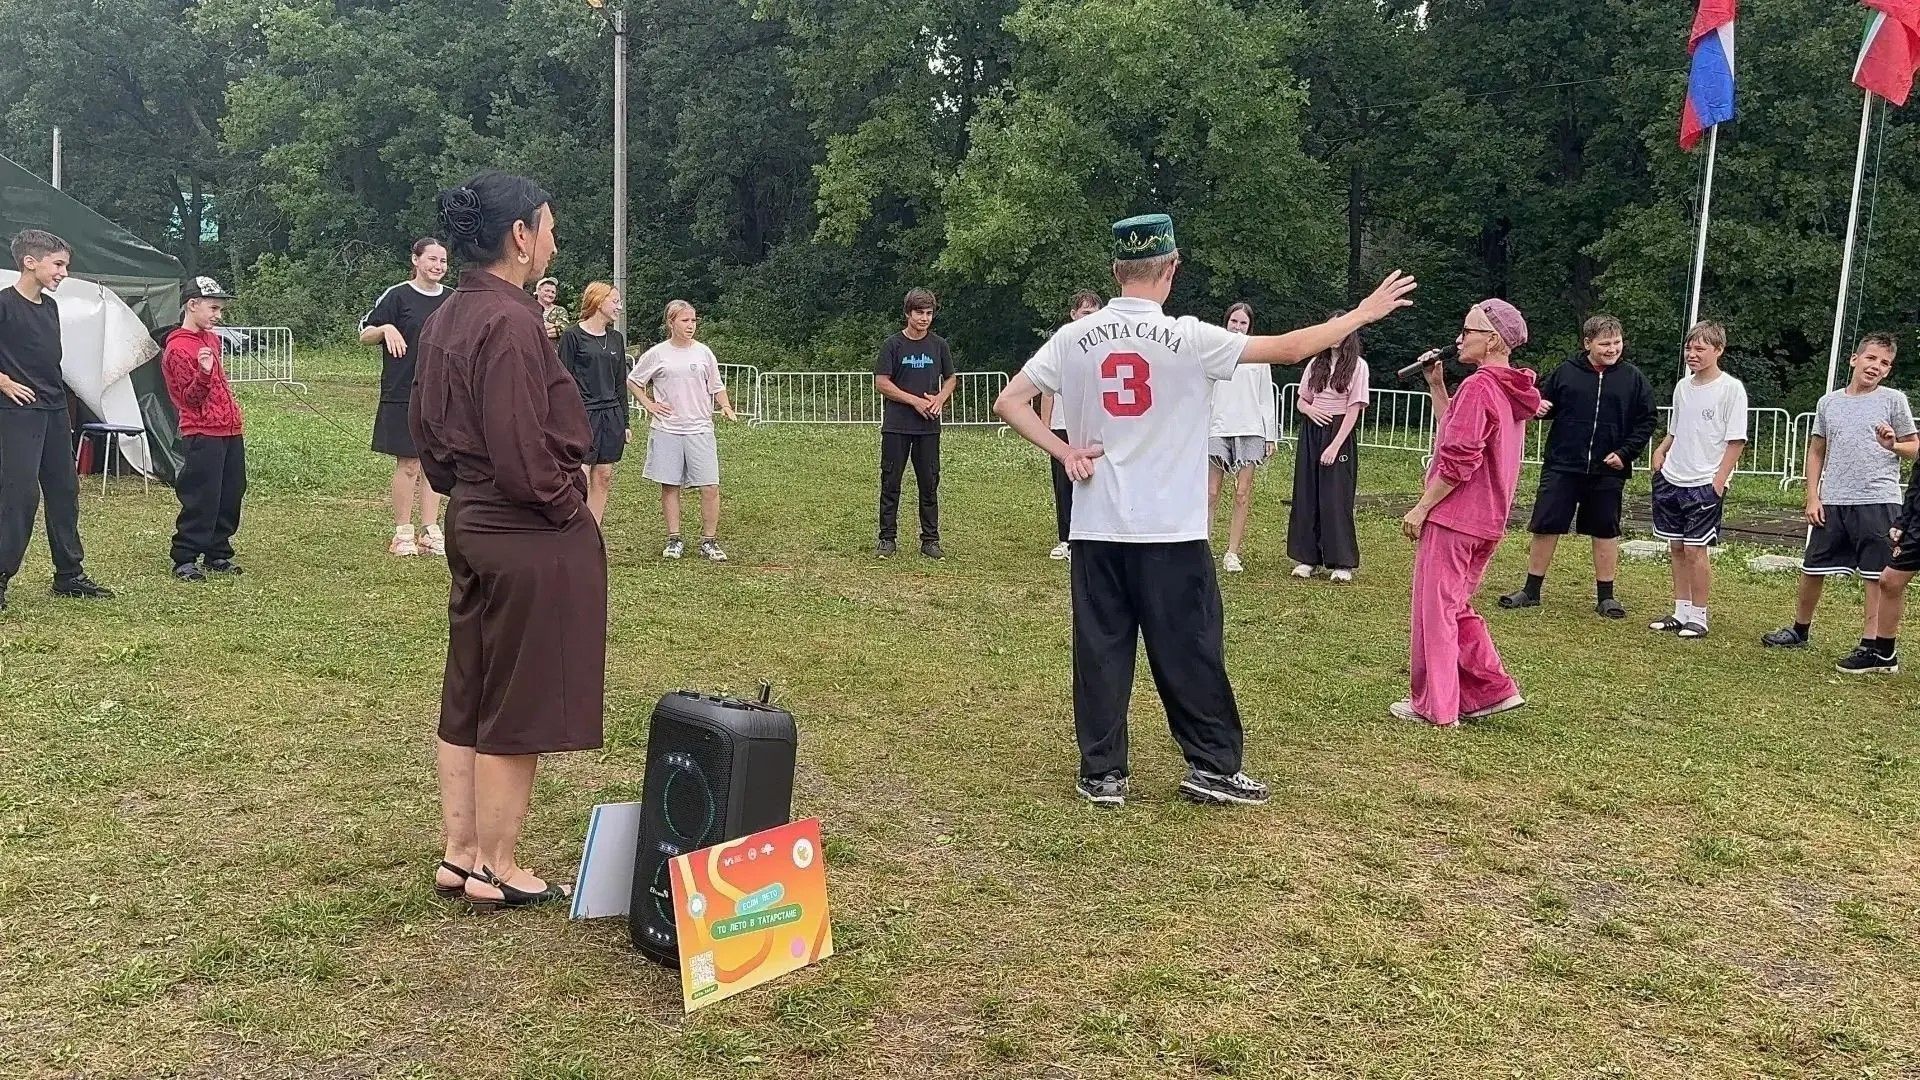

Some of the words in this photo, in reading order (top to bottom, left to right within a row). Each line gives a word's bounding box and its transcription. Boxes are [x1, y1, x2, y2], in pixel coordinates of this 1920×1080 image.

[1077, 322, 1131, 354] PUNTA
[1135, 322, 1182, 354] CANA
[1101, 352, 1152, 417] 3
[742, 897, 759, 911] ЕСЛИ
[761, 889, 778, 902] ЛЕТО
[717, 925, 727, 934] ТО
[729, 920, 747, 931] ЛЕТО
[750, 918, 755, 927] В
[758, 908, 797, 926] ТАТАРСТАНЕ
